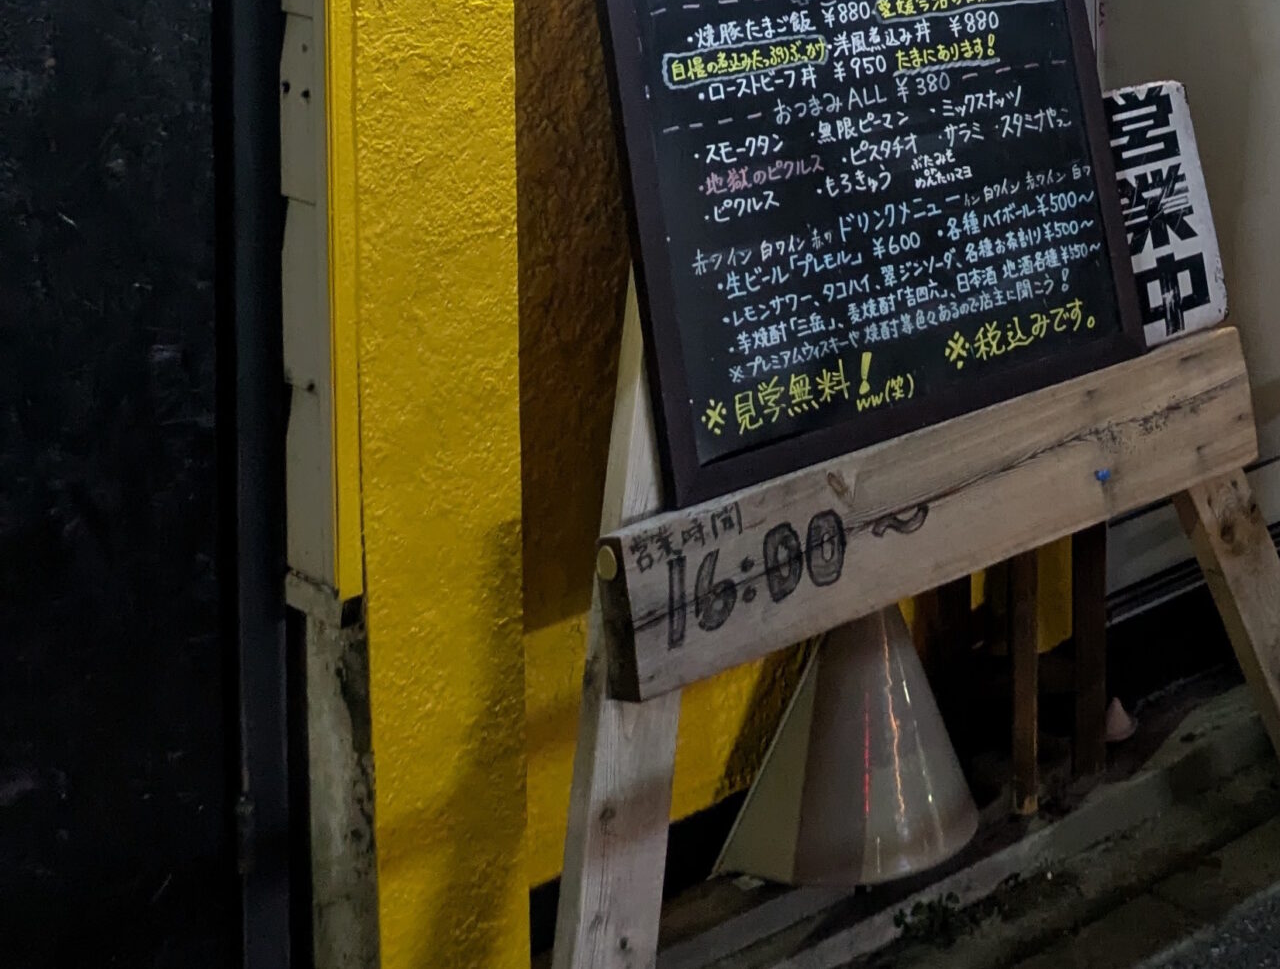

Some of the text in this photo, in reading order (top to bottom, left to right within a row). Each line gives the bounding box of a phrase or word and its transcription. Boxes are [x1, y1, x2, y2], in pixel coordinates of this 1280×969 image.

[694, 10, 817, 49] 焼豚たまご飯
[832, 17, 931, 59] 洋風煮込み丼
[707, 63, 818, 102] ローストビーフ丼
[772, 92, 844, 126] おつまみ
[847, 84, 888, 111] ALL
[704, 84, 1023, 164] スモークタン 無限ピーマン ミックスナッツ
[704, 154, 825, 197] 地獄のピクルス
[850, 132, 918, 167] ピスタチオ
[942, 122, 985, 148] サラミ
[910, 148, 956, 171] ぶたみそ
[713, 163, 892, 223] ピクルス もろきゅう
[1103, 84, 1211, 337] 営業中
[839, 194, 961, 243] ドリンクメニュー
[630, 501, 743, 573] 営業時間
